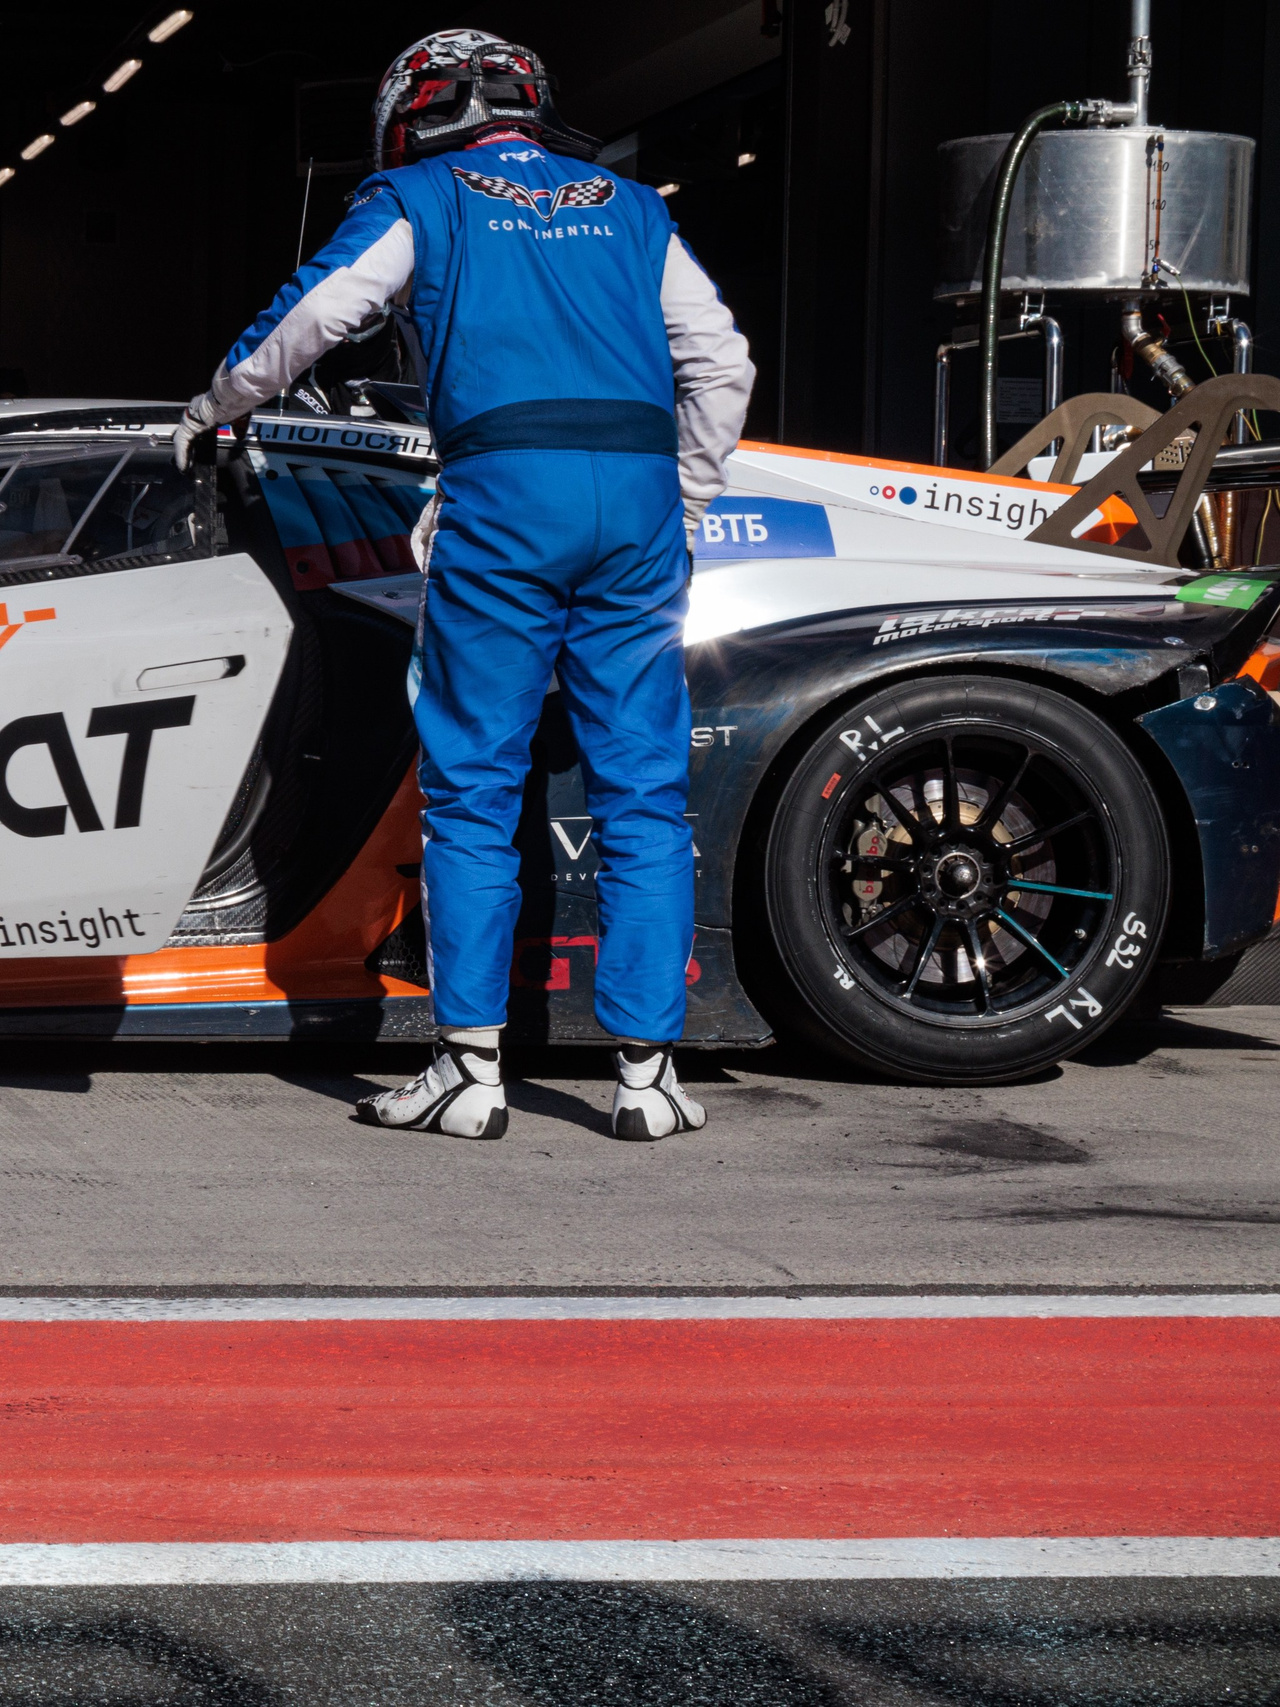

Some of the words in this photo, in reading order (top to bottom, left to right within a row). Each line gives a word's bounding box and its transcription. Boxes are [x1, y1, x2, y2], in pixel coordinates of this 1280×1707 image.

[492, 108, 536, 118] FEATHERLITE
[488, 219, 613, 240] CONINENTAL
[923, 482, 1059, 531] insigh
[702, 513, 769, 543] ВТБ
[872, 615, 1053, 646] motorsport
[1106, 911, 1148, 970] S32
[832, 964, 856, 991] RL
[1043, 986, 1103, 1030] RL
